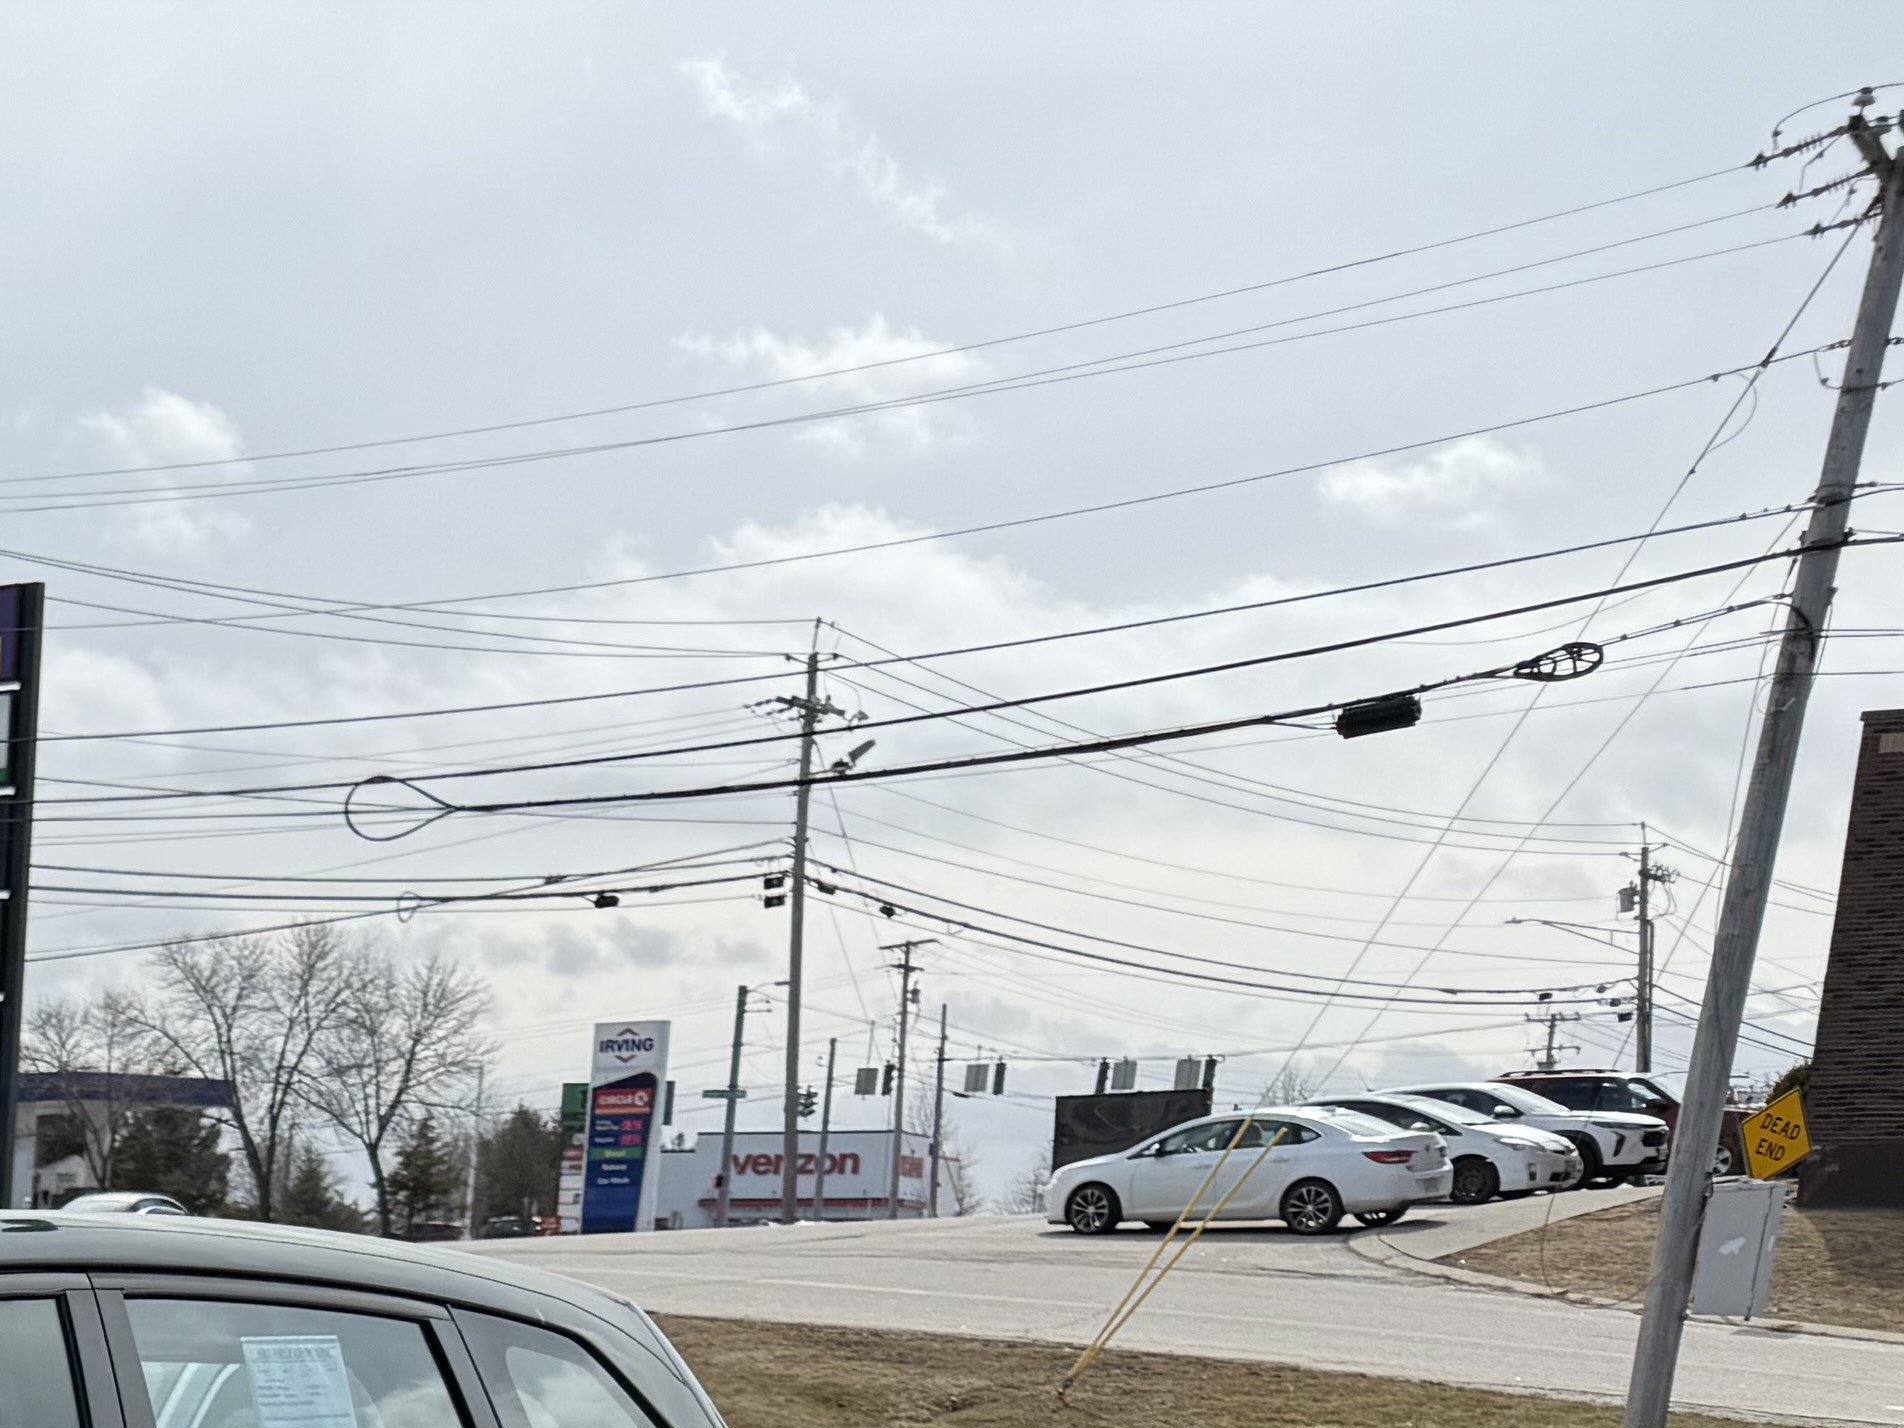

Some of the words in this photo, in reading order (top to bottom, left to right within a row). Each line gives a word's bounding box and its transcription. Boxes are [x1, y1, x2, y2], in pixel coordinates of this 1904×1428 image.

[599, 1037, 655, 1054] IRVING
[1760, 1112, 1802, 1142] DEAD
[1755, 1137, 1787, 1162] END
[732, 1151, 861, 1176] verzon
